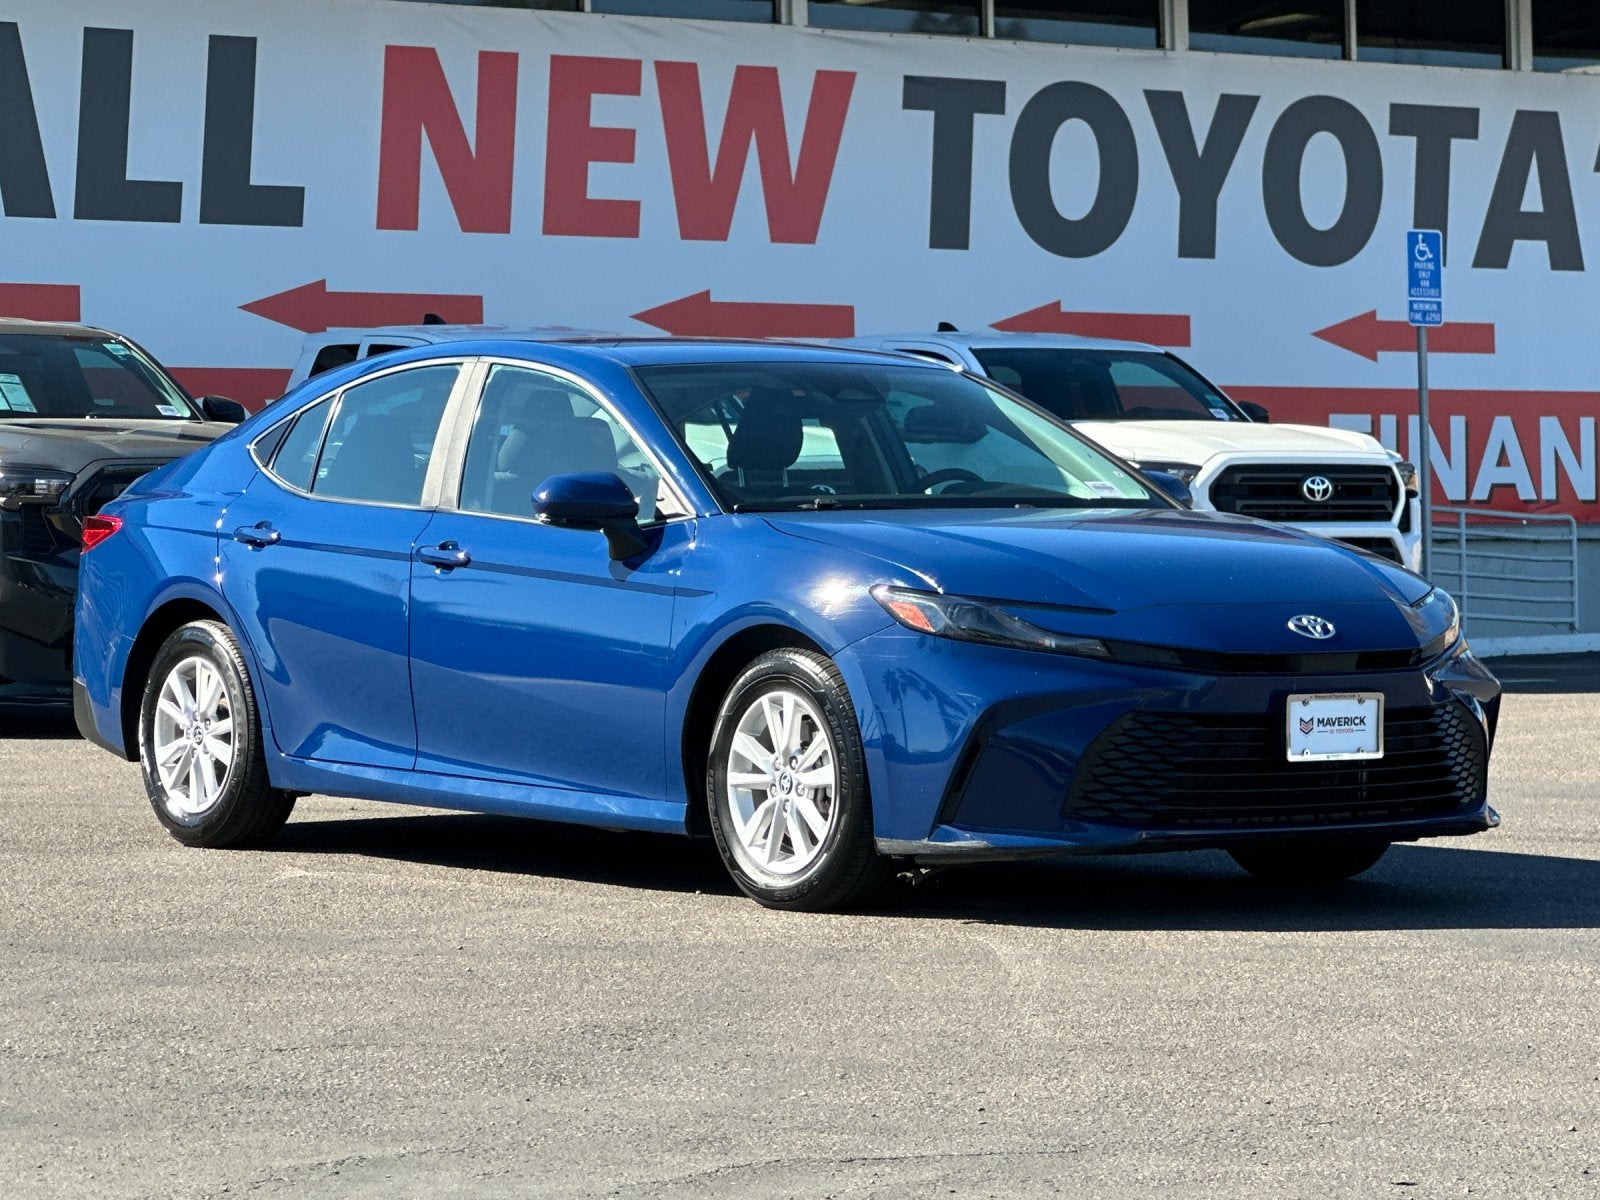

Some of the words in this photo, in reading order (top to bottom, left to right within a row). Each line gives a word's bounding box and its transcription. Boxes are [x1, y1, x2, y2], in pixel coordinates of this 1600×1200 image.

[376, 44, 857, 244] NEW
[902, 75, 1600, 272] TOYOTA
[1414, 261, 1435, 270] PARKING
[1418, 270, 1431, 279] ONLY
[1420, 279, 1430, 287] VAN
[1410, 312, 1423, 321] FINE
[1329, 413, 1596, 501] NAN
[1317, 716, 1367, 728] MAVERICK
